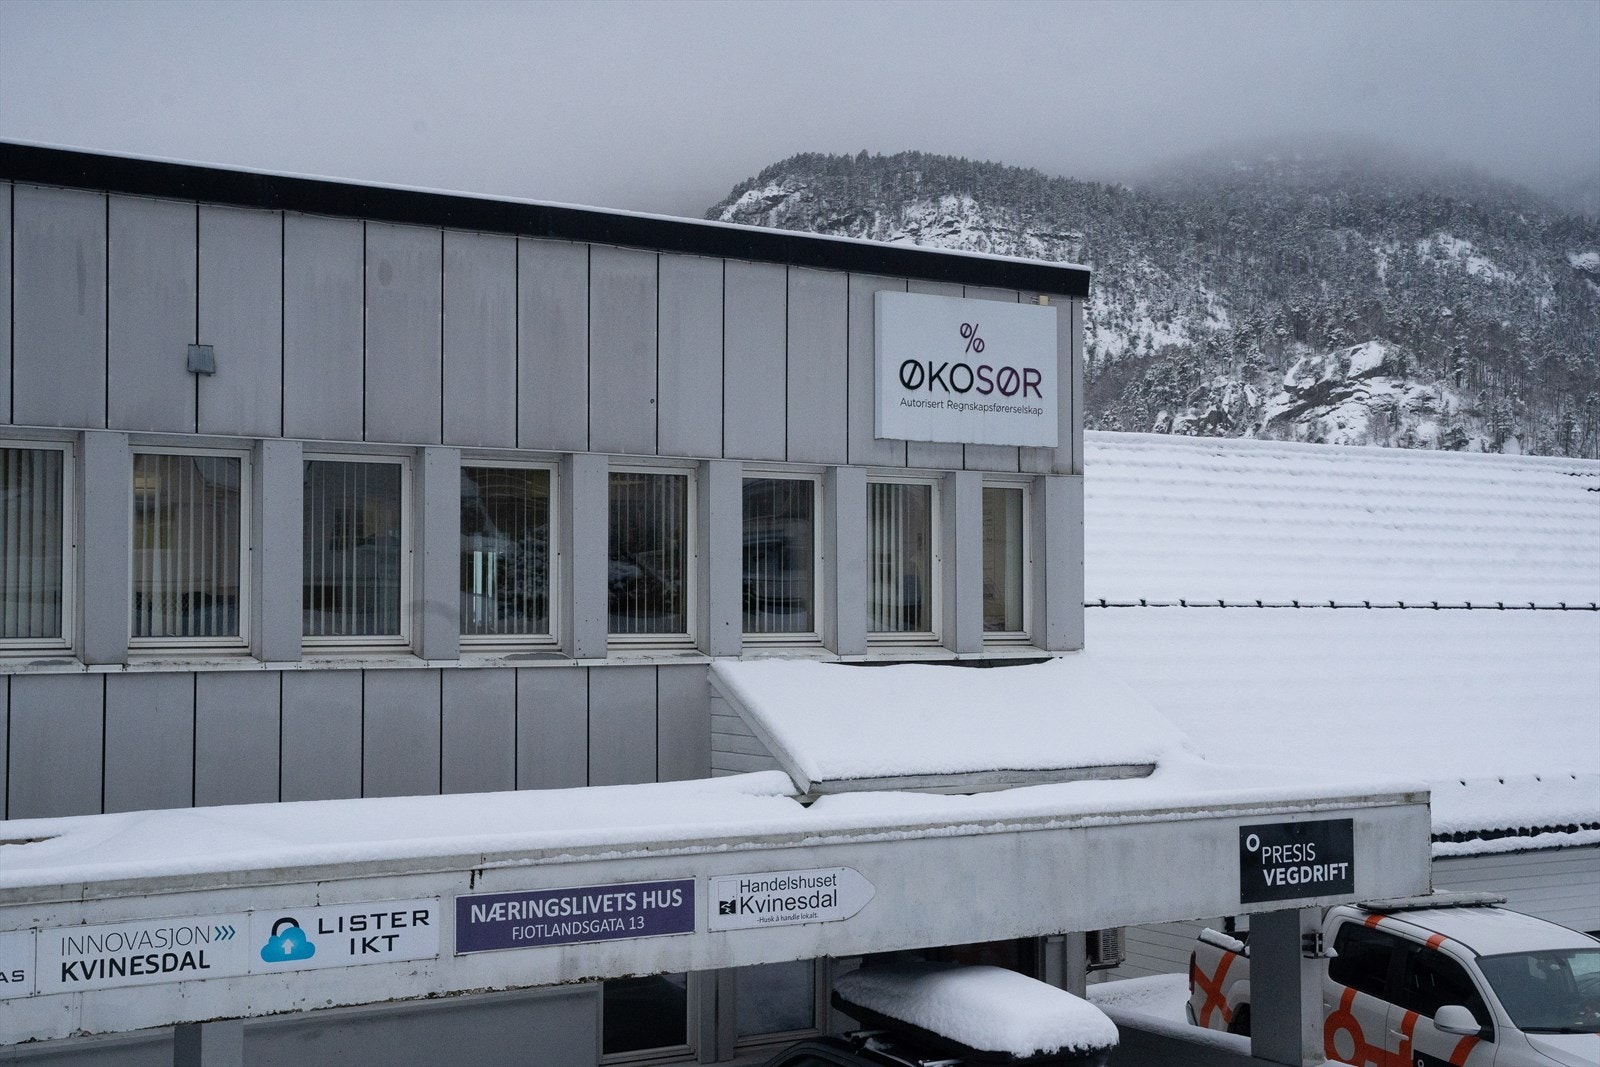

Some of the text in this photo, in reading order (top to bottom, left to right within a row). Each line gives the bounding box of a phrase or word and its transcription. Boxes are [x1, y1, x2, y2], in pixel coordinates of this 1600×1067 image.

[899, 358, 1043, 399] ØKOSØR
[900, 397, 1043, 416] Autorisert Regnskapsførerselskap
[1262, 842, 1316, 865] PRESIS
[740, 873, 837, 893] Handelshuset
[1262, 862, 1349, 887] VEGDRIFT
[471, 888, 683, 924] NÆRINGSLIVETS HUS
[740, 889, 837, 915] Kvinesdal
[318, 909, 430, 935] LISTER
[512, 916, 645, 941] FJOTLANDSGATA 13
[780, 913, 800, 921] handle
[61, 924, 211, 957] INNOVASJON
[350, 934, 400, 956] IKT
[61, 950, 211, 983] KVINESDAL
